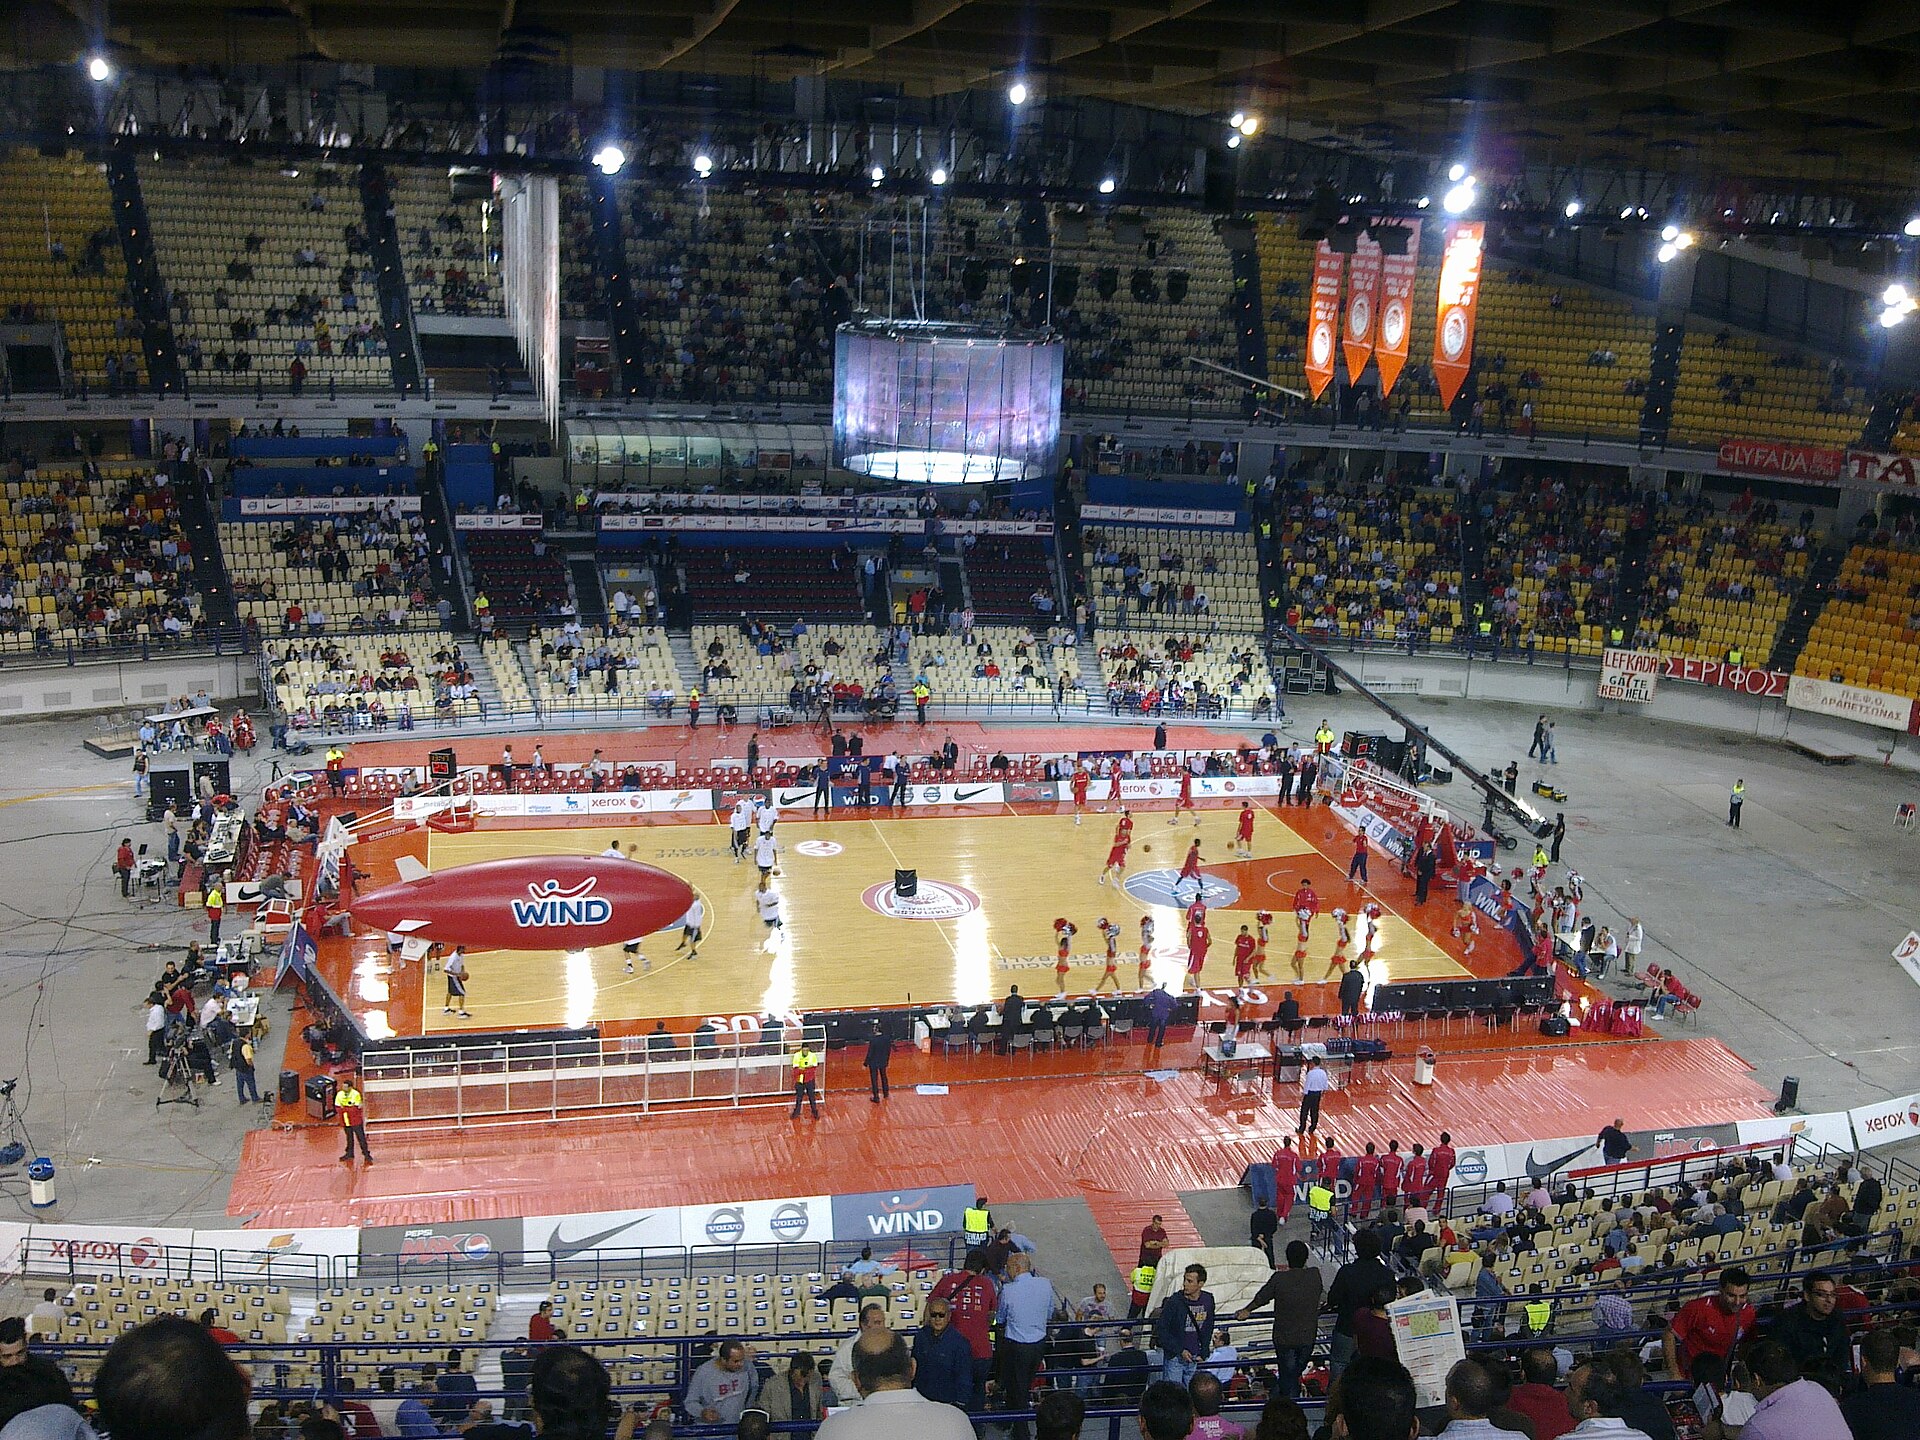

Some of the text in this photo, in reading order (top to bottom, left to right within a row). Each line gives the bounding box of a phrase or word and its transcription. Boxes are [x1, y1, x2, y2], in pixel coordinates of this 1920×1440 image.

[1720, 445, 1807, 474] GLYFADA
[1604, 650, 1658, 674] LEFKADA
[1664, 656, 1790, 698] ΣΕΡΙΦΟΣ
[1601, 685, 1651, 702] RED HELL
[591, 796, 627, 808] xerox
[513, 899, 611, 926] WIND
[1864, 1111, 1905, 1133] xerox
[1654, 1133, 1675, 1141] PEPSI
[1457, 1165, 1486, 1174] VOLVO
[709, 1223, 743, 1233] VOLVO
[773, 1218, 807, 1228] VOLVO
[867, 1209, 943, 1235] WIND
[405, 1229, 433, 1237] PEPSI
[50, 1240, 121, 1260] xerox
[400, 1233, 471, 1265] MAX
